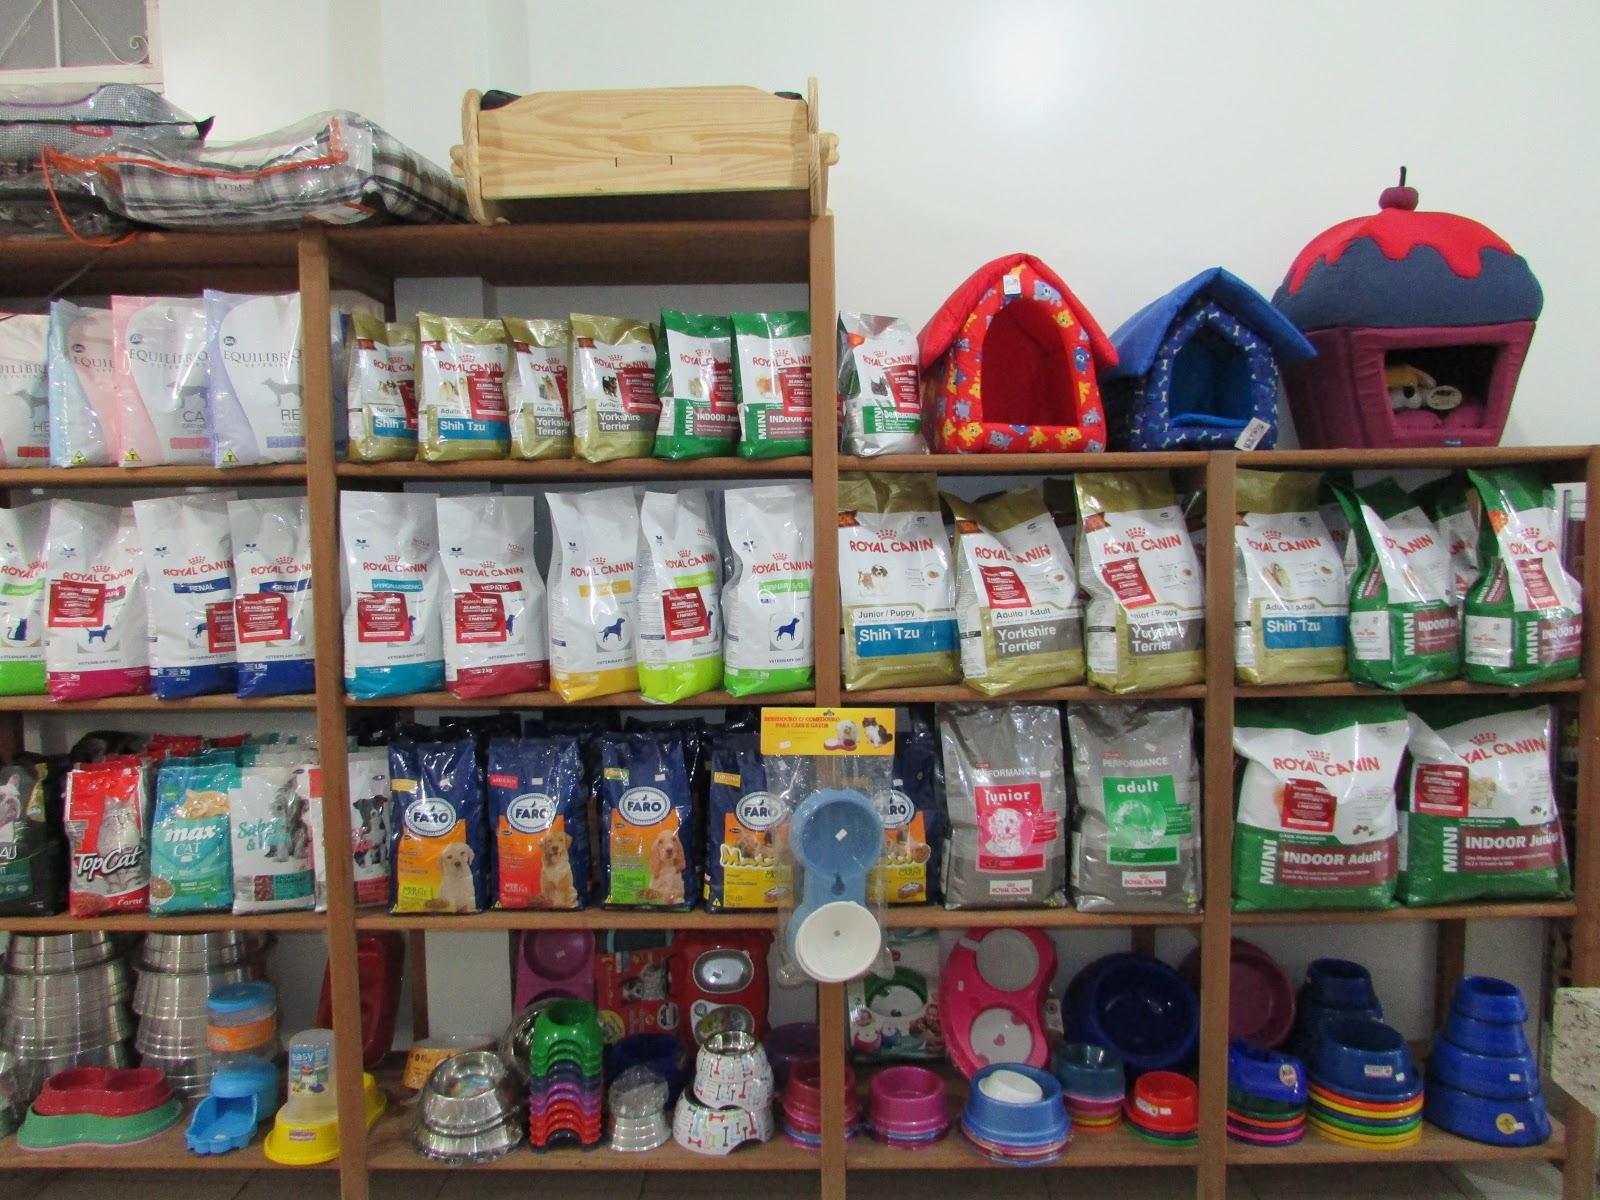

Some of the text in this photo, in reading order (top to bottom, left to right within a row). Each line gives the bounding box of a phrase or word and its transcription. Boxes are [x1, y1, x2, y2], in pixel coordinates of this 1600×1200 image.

[439, 361, 501, 372] ROYAL CANIN
[594, 357, 649, 369] ROYAL CANIN
[752, 357, 779, 367] ROYAL
[183, 411, 206, 423] CA
[281, 409, 301, 421] RE
[600, 413, 641, 422] Yorkshire
[685, 406, 694, 436] MINI
[697, 413, 726, 421] INDOOR
[769, 415, 802, 423] INDOOR
[874, 407, 883, 432] MINI
[375, 418, 398, 428] Shih
[440, 421, 486, 431] Shih Tzu
[600, 422, 630, 431] Terrier
[757, 410, 766, 440] MINI
[536, 427, 565, 436] Terrier
[849, 539, 934, 553] ROYAL CANIN
[1104, 534, 1182, 554] ROYAL CANIN
[1279, 537, 1321, 552] CANIN
[1397, 534, 1434, 555] ANIN
[688, 553, 716, 567] CANIN
[975, 546, 1011, 561] ROYAL
[1, 566, 34, 579] ROYAL
[163, 559, 235, 576] ROYAL CANIN
[251, 566, 283, 575] ROYAL
[363, 563, 428, 573] ROYAL CANIN
[459, 567, 524, 577] ROYAL CANIN
[601, 562, 634, 576] CANIN
[752, 560, 815, 574] ROYAL CANIN
[63, 572, 99, 582] ROYAL
[858, 610, 884, 619] Junior
[890, 609, 915, 618] Puppy
[996, 610, 1023, 619] Adulto
[1030, 607, 1051, 616] Adult
[997, 625, 1057, 641] Yorkshire
[1266, 620, 1320, 633] Shih Tzu
[859, 628, 920, 641] Shih Tzu
[1404, 613, 1415, 656] MINI
[999, 641, 1041, 653] Terrier
[1132, 641, 1172, 652] Terrier
[1526, 621, 1538, 664] MINI
[1493, 739, 1546, 755] CANIN
[1103, 757, 1168, 767] PERFORMANCE
[1273, 757, 1380, 776] ROYAL CANIN
[1117, 781, 1160, 793] adult
[627, 801, 661, 812] FARO
[413, 812, 448, 823] FARO
[1465, 836, 1526, 849] INDOOR
[1443, 827, 1458, 872] MINI
[75, 847, 143, 880] TopCat
[1259, 840, 1277, 885] MINI
[1283, 850, 1381, 865] INDOOR Adult
